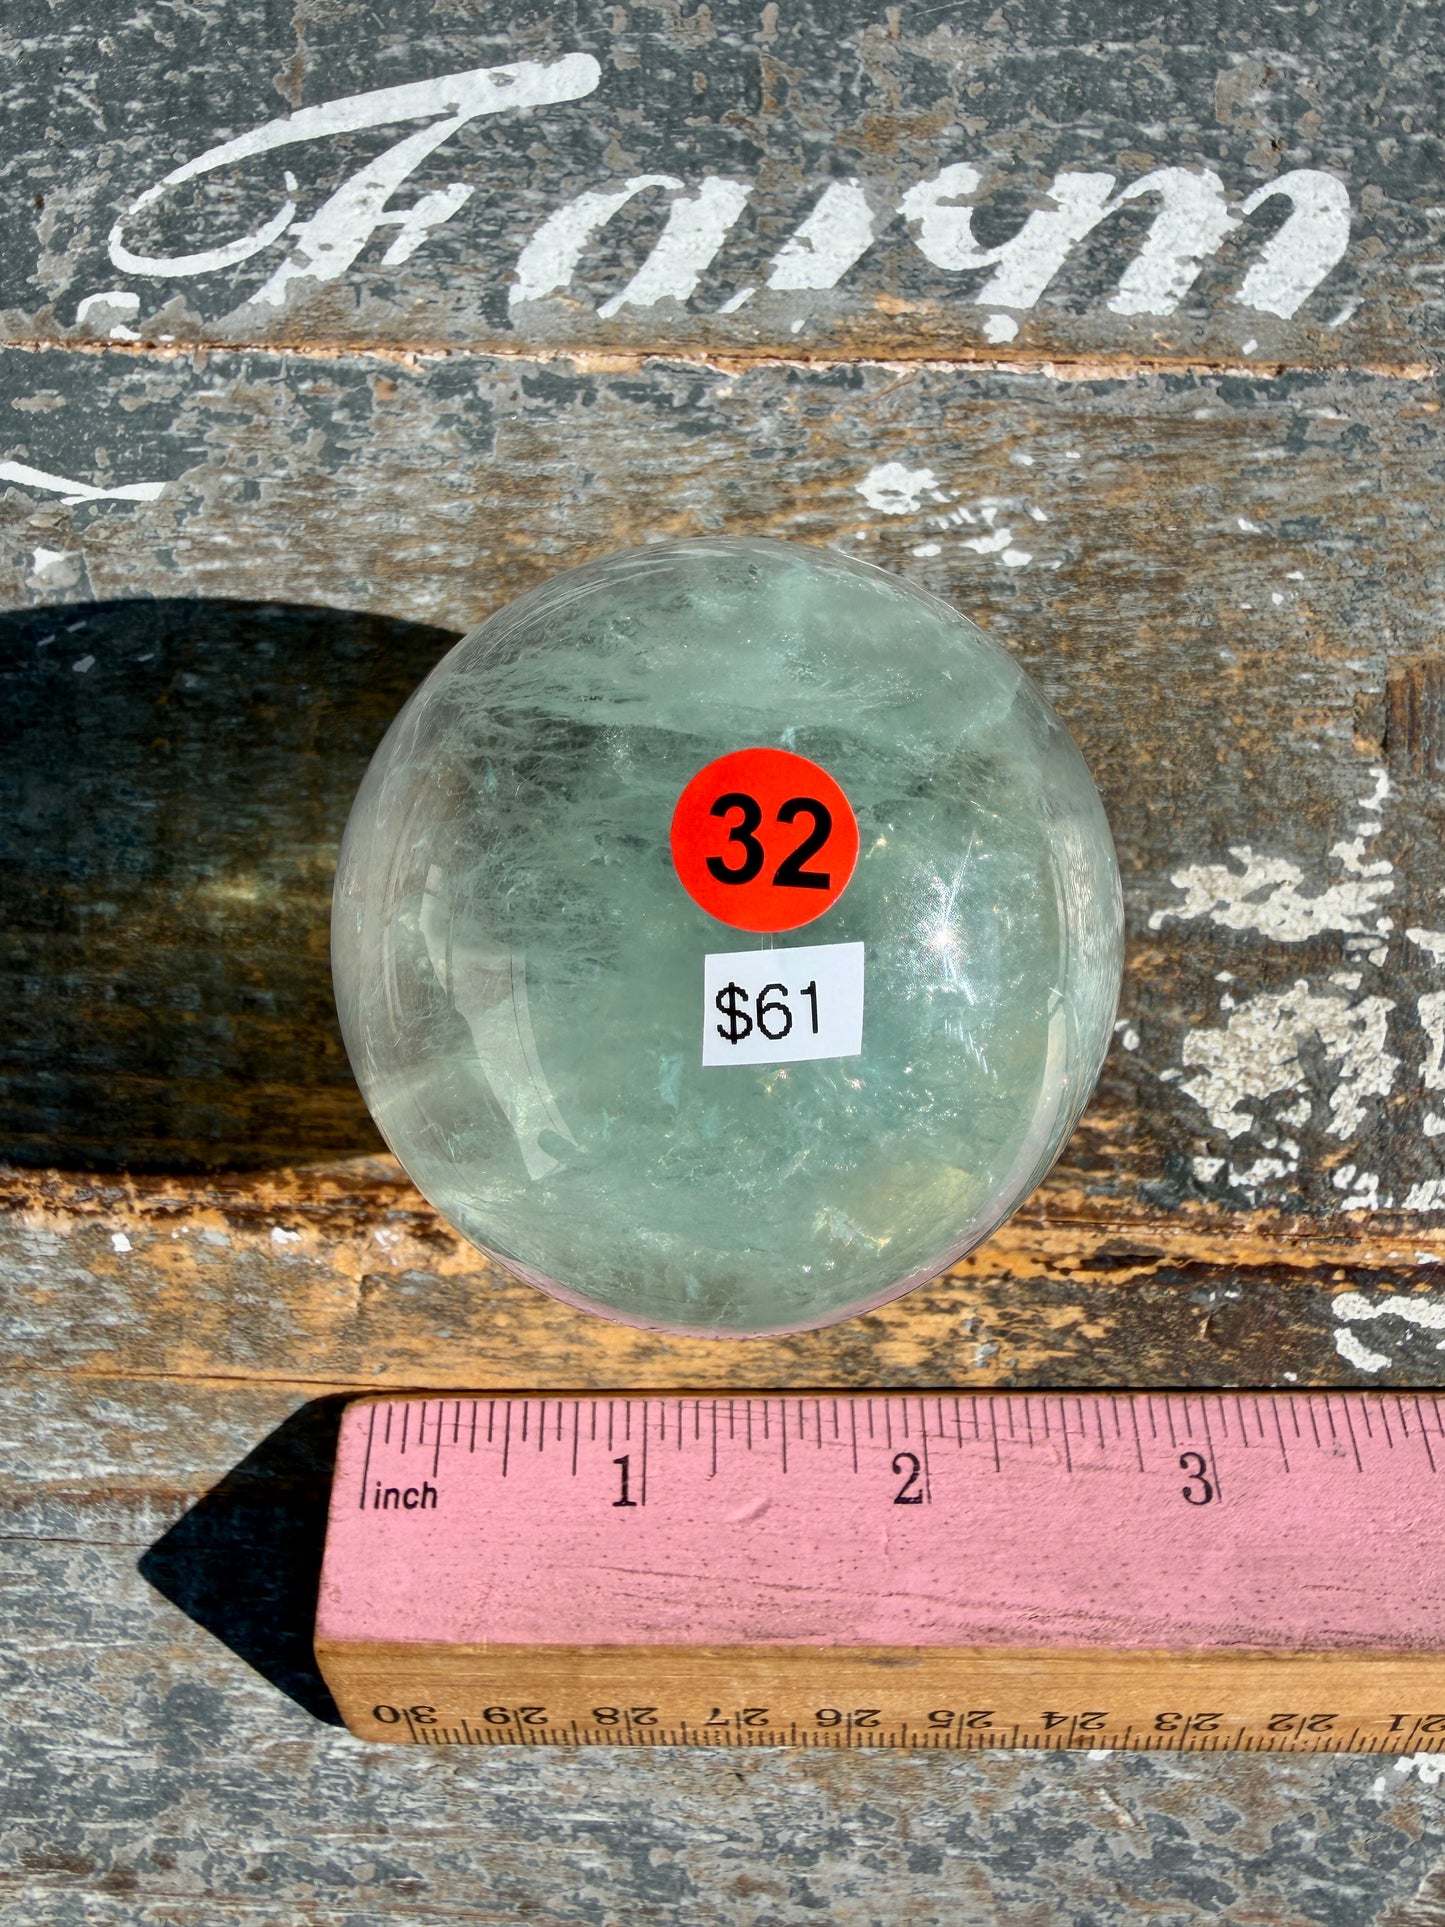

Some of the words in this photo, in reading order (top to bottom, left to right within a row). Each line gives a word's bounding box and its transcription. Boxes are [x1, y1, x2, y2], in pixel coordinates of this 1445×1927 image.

[705, 792, 832, 890] 32
[715, 980, 819, 1045] $61
[612, 1454, 637, 1507] 1
[892, 1452, 923, 1505] 2
[1180, 1452, 1214, 1505] 3
[373, 1481, 438, 1510] inch
[373, 1704, 438, 1725] 30
[482, 1706, 548, 1725] 29
[592, 1706, 658, 1726] 28
[704, 1707, 769, 1726] 27
[815, 1708, 881, 1728] 26
[927, 1709, 996, 1729] 25
[1040, 1711, 1109, 1730] 24
[1154, 1712, 1224, 1731] 23
[1267, 1713, 1340, 1732] 22
